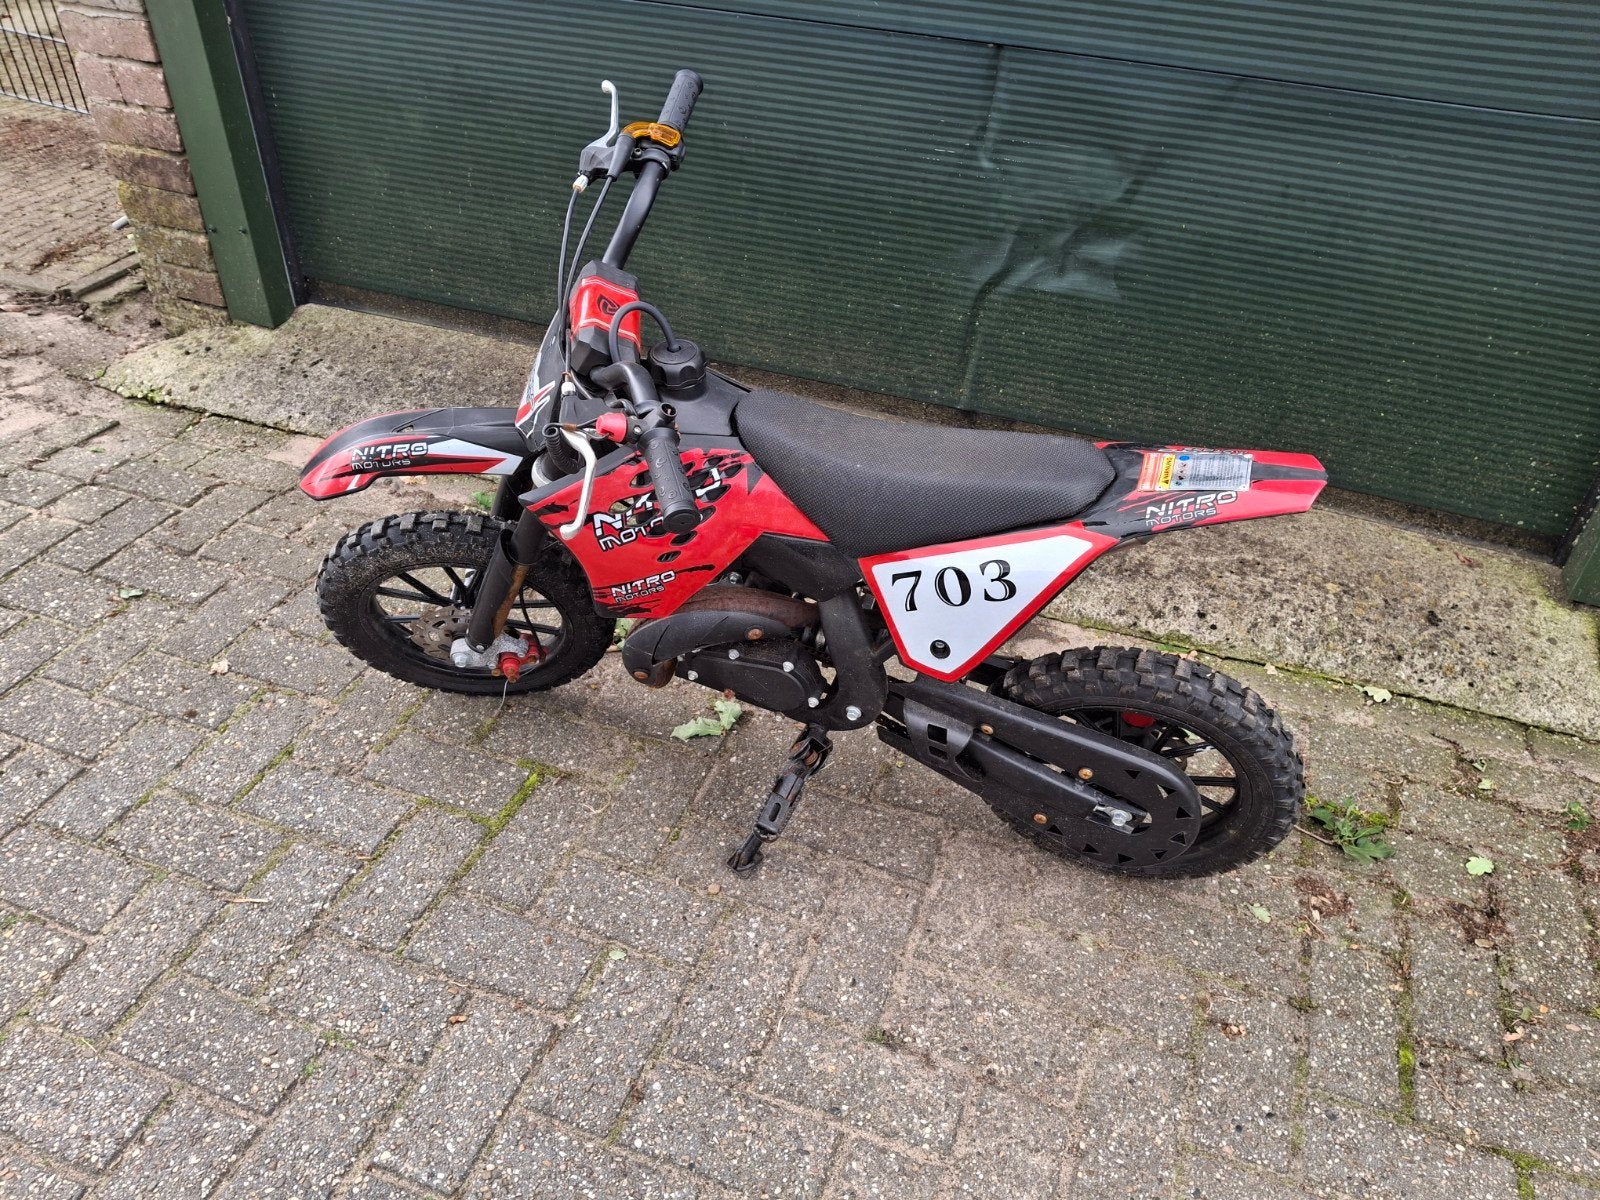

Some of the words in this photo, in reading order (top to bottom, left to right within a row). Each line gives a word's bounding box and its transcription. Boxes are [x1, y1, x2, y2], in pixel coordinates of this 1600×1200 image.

[351, 442, 428, 461] NITRO
[352, 459, 411, 470] MOTORS
[1145, 490, 1237, 519] NITRO
[1146, 507, 1217, 526] MOTORS
[611, 570, 676, 597] NITRO
[891, 559, 1017, 612] 703
[615, 585, 665, 603] MOTORS
